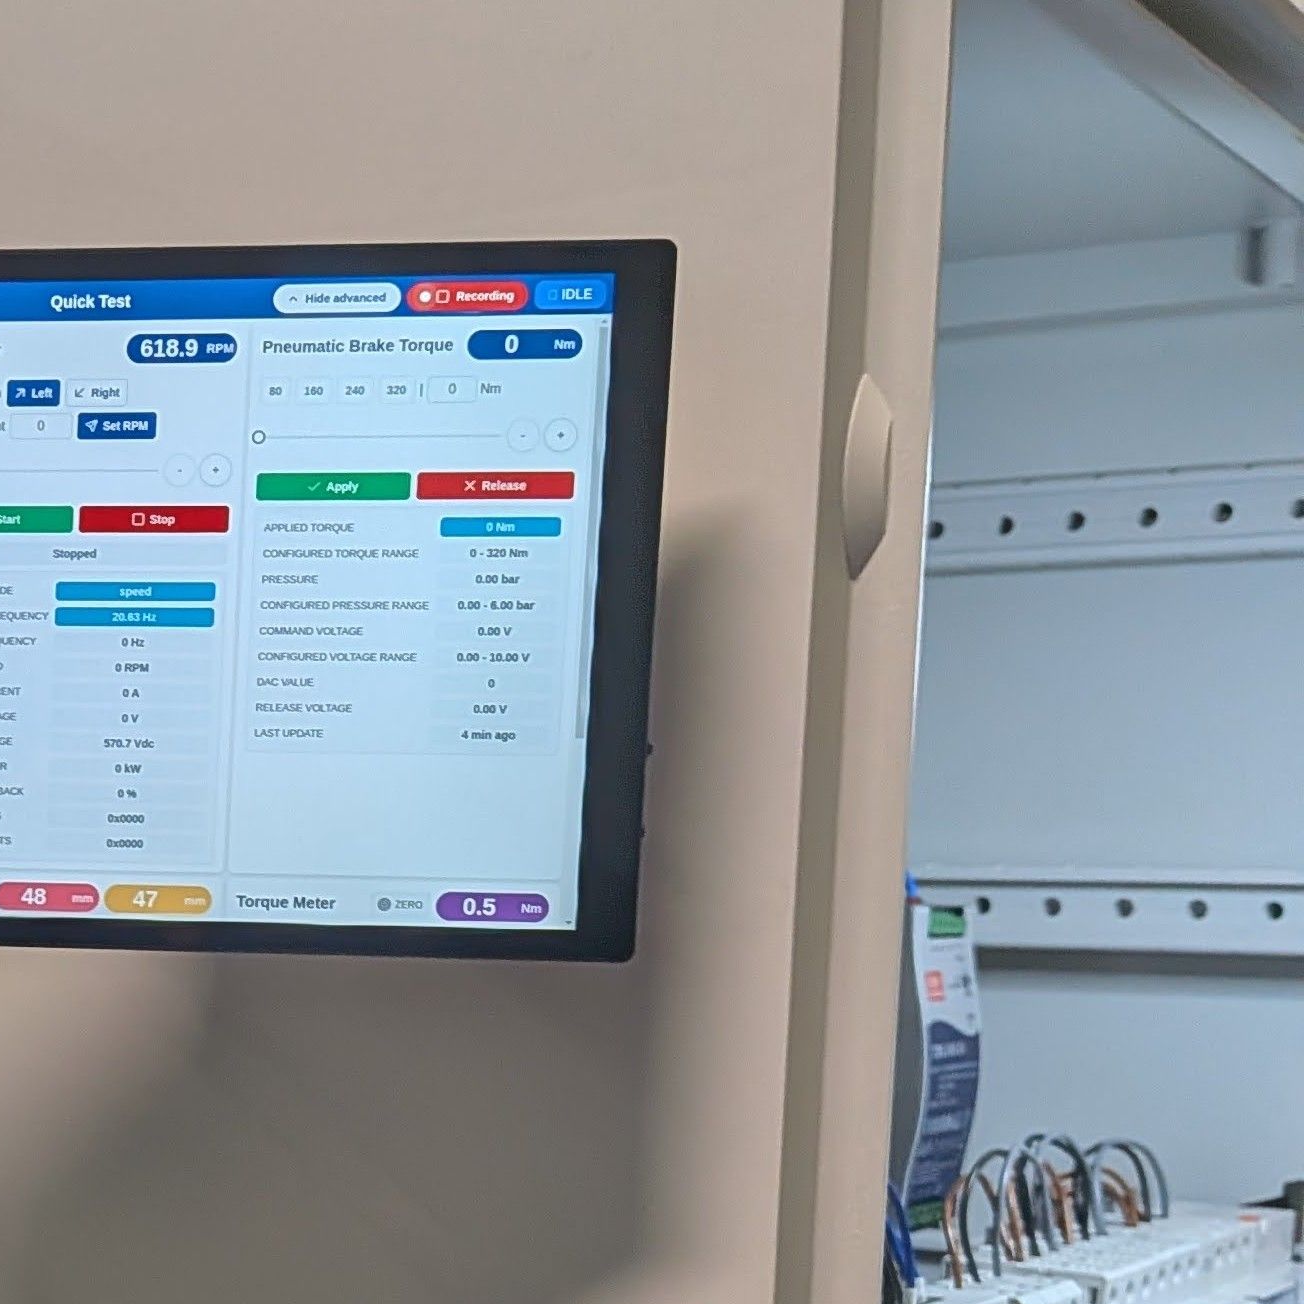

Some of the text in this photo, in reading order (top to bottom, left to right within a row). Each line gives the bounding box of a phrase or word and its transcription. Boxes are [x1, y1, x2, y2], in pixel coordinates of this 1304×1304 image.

[305, 292, 386, 304] Hide advanced
[456, 290, 515, 303] Recording
[561, 289, 592, 300] IDLE
[50, 294, 131, 311] Quick Test
[140, 339, 234, 358] 618.9 RPM
[263, 338, 453, 354] Pneumatic Brake Torque
[505, 335, 519, 353] 0
[554, 339, 575, 350] Nm
[32, 387, 53, 398] Left
[91, 387, 120, 399] Right
[269, 383, 501, 396] 80 160 240 320 0 Nm
[103, 420, 148, 431] Set RPM
[326, 481, 359, 494] Apply
[482, 480, 527, 491] Release
[149, 514, 175, 526] Stop
[264, 523, 354, 534] APPLIED TORQUE
[486, 522, 515, 532] 0 Nm
[52, 549, 97, 560] Stopped
[263, 549, 419, 560] CONFIGURED TORQUE RANGE
[470, 549, 528, 558] 0 320 Nm
[262, 574, 318, 585] PRESSURE
[476, 574, 520, 584] 0.00 bar
[119, 587, 152, 598] speed
[260, 600, 429, 610] CONFIGURED PRESSURE RANGE
[458, 600, 480, 610] 0.00
[516, 600, 535, 610] bar
[112, 612, 157, 622] 20.63 Hz
[259, 626, 363, 636] COMMAND VOLTAGE
[478, 626, 512, 637] 0.00 V
[258, 652, 417, 662] CONFIGURED VOLTAGE RANGE
[457, 653, 530, 663] 0.00 10.00 V
[257, 678, 314, 687] DAC VALUE
[256, 703, 352, 714] RELEASE VOLTAGE
[473, 705, 507, 715] 0.00 V
[254, 729, 324, 739] LAST UPDATE
[461, 730, 516, 743] 4 min ago
[104, 738, 154, 749] 570.7 Vdc
[21, 888, 46, 905] 48
[71, 894, 94, 903] mm
[133, 891, 158, 907] 47
[184, 897, 206, 906] mm
[236, 895, 336, 909] Torque Meter
[395, 900, 423, 909] ZERO
[462, 898, 496, 916] 0.5
[521, 903, 542, 914] Nm
